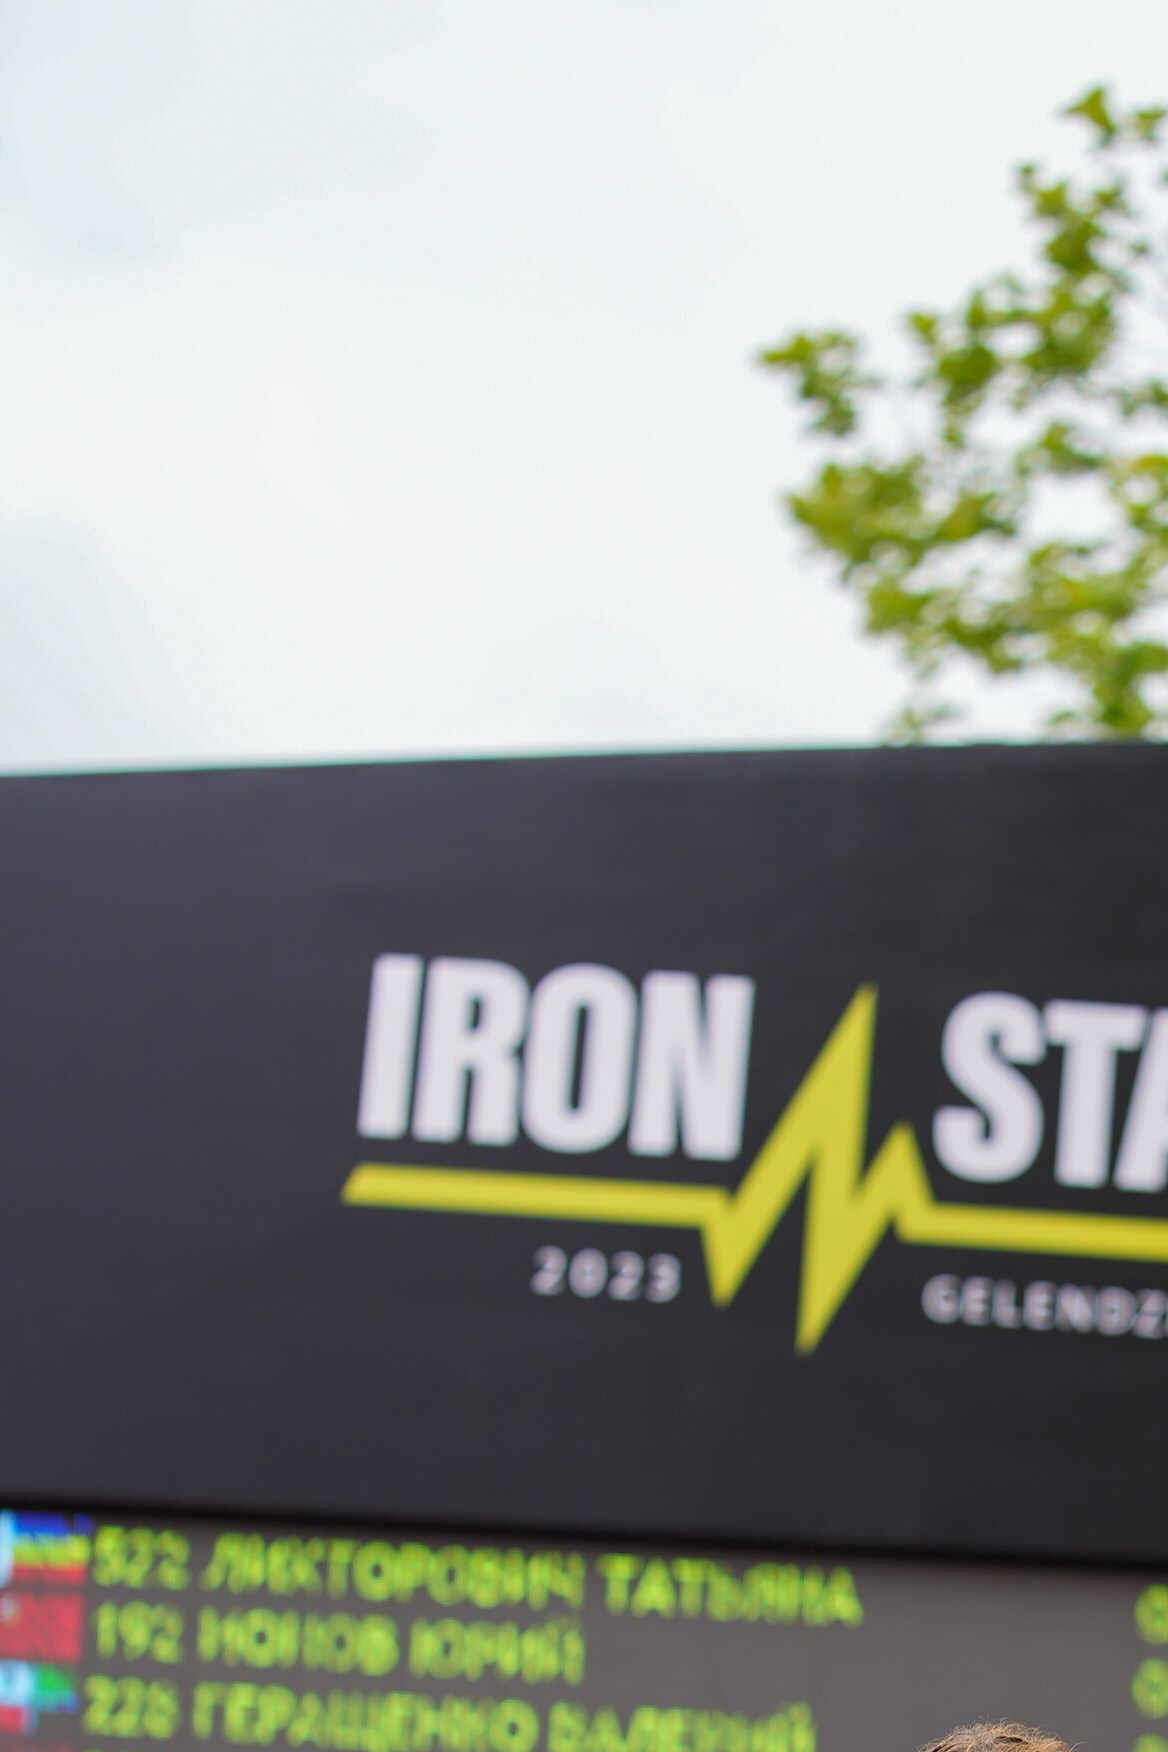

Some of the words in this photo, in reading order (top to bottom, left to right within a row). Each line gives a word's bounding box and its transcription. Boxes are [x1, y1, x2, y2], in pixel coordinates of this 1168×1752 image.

[358, 954, 756, 1161] IRON
[531, 1246, 682, 1303] 2023
[93, 1524, 190, 1590] 522
[92, 1600, 184, 1664] 192
